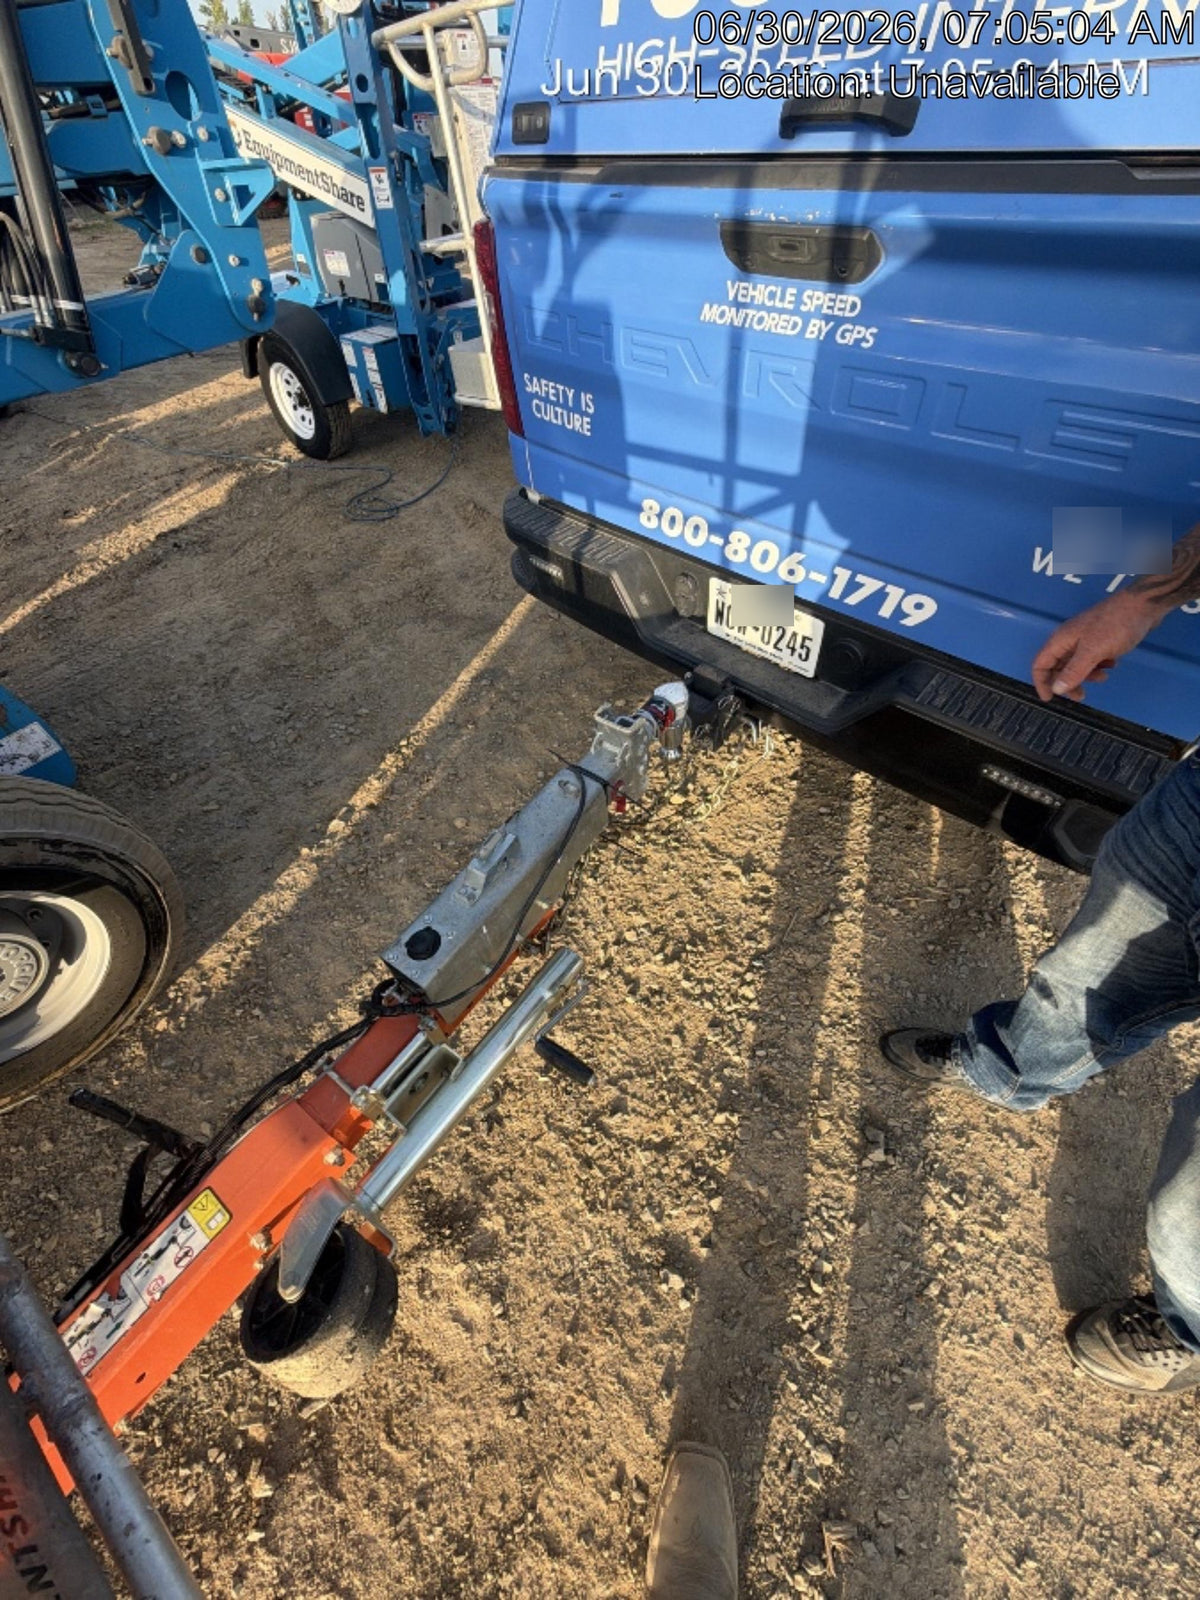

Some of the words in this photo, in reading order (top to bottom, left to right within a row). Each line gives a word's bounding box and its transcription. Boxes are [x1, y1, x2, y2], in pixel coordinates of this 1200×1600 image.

[242, 128, 366, 213] EquipmentShare
[726, 280, 797, 310] VEHICLE
[800, 289, 862, 318] SPEED
[700, 303, 803, 336] MONITORED
[805, 319, 835, 341] BY
[835, 323, 879, 349] GPS
[523, 372, 576, 408] SAFETY
[581, 391, 595, 415] IS
[532, 398, 592, 437] CULTURE
[639, 498, 938, 627] 800-806-1719
